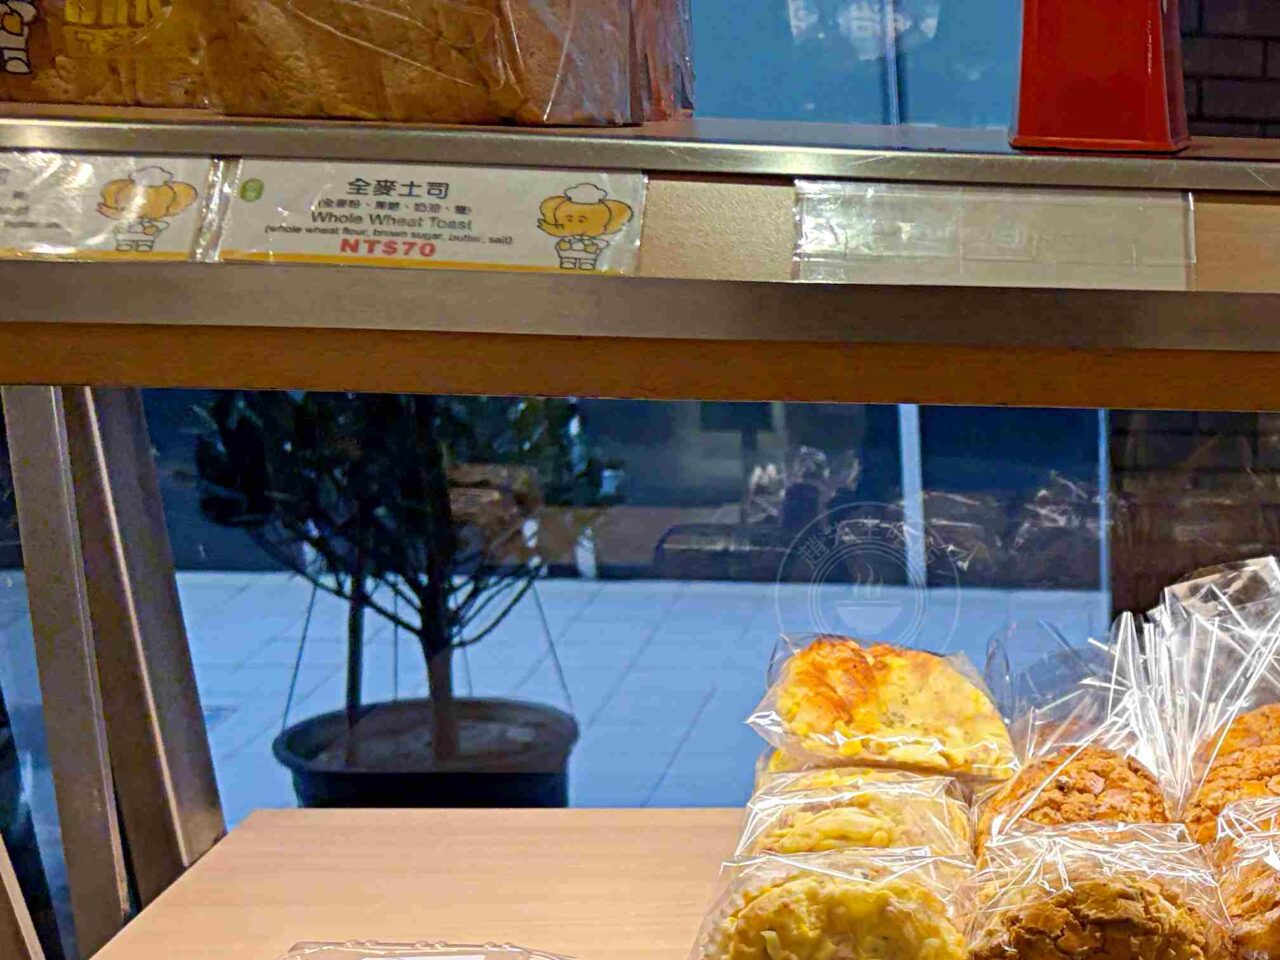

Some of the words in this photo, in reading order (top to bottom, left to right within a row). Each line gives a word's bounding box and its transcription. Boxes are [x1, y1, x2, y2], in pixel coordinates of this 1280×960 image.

[346, 178, 450, 199] 全麥土司
[312, 211, 363, 225] Whole
[370, 214, 423, 228] Wheat
[429, 216, 473, 231] Toast
[340, 238, 436, 257] NT$70
